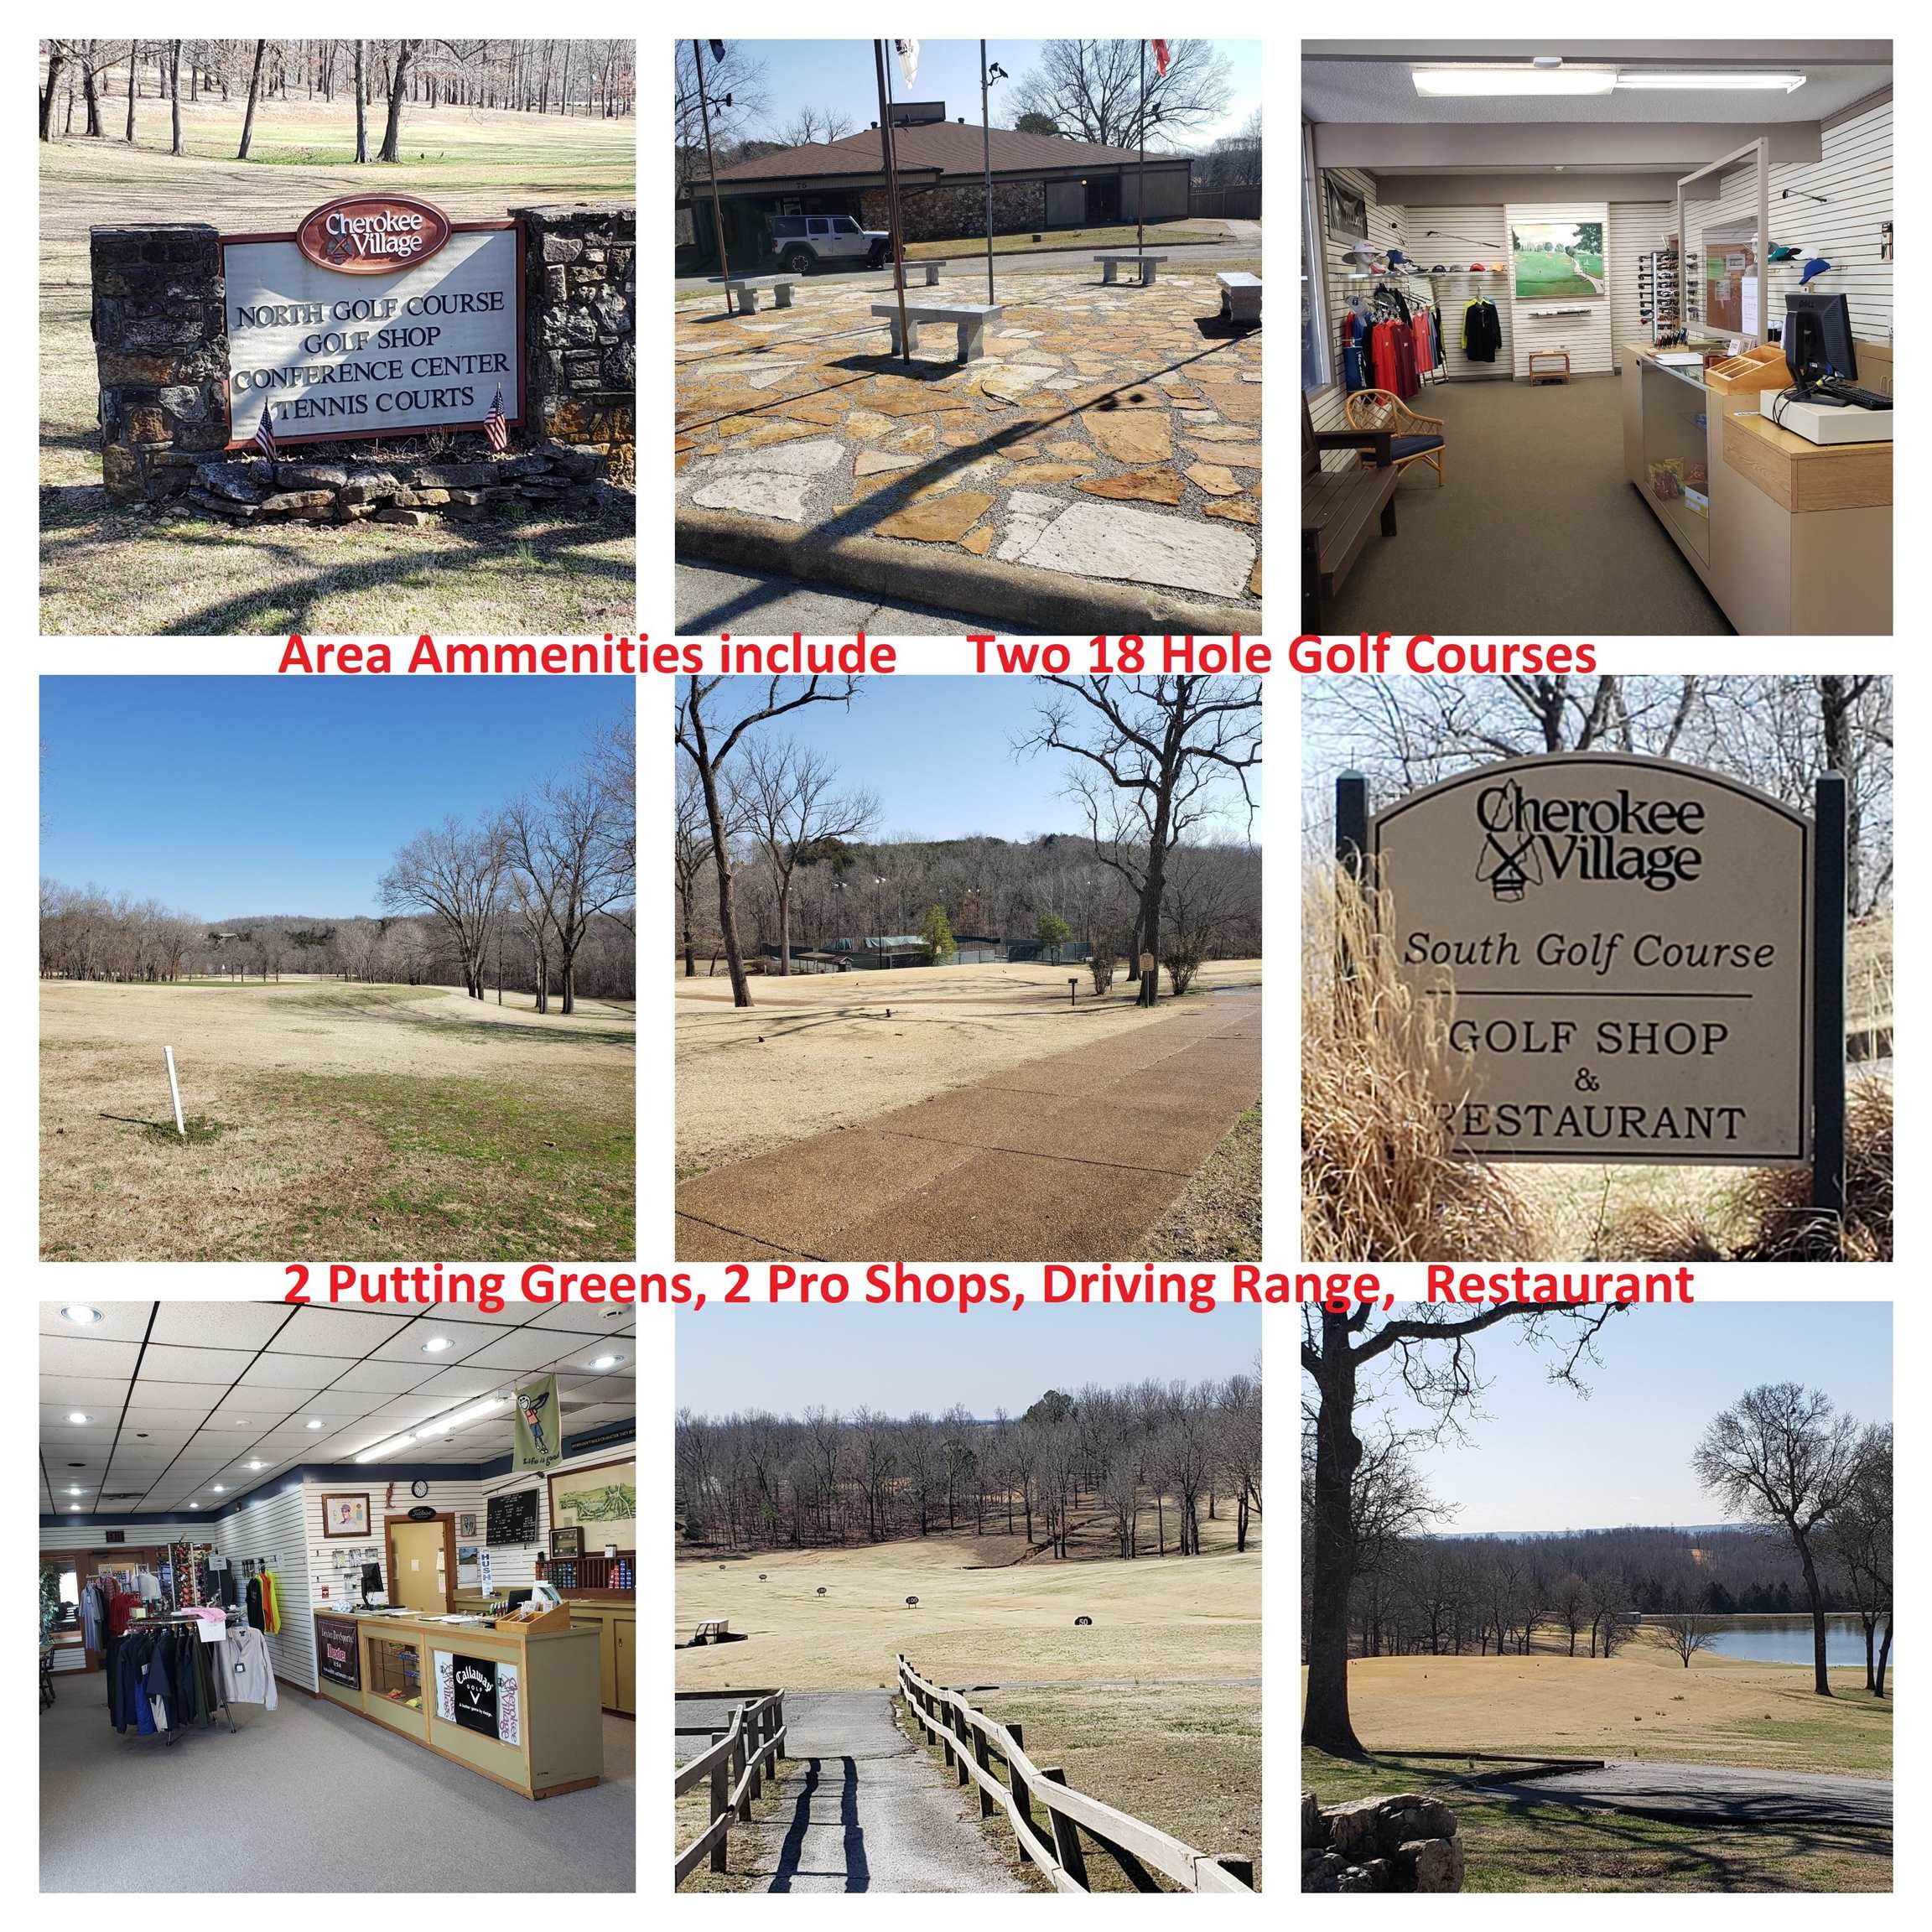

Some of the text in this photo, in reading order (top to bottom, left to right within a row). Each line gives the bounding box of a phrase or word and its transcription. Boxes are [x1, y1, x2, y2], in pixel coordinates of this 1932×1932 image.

[325, 210, 423, 236] Cherokee
[351, 232, 423, 257] Village
[236, 291, 505, 328] NORTH GOLF COURSE
[304, 326, 441, 355] GOLF SHOP
[234, 352, 510, 390] CONFERENCE CENTER
[274, 386, 474, 420] TENNIS COURTS
[1476, 785, 1706, 835] Cherokee
[1534, 833, 1702, 891] Village
[1404, 932, 1775, 975] South Golf Course
[1449, 1021, 1729, 1056] GOLF SHOP
[1574, 1067, 1600, 1093] &
[455, 1665, 493, 1692] Callaway
[499, 1695, 509, 1738] Village
[508, 1677, 518, 1743] Cherokee
